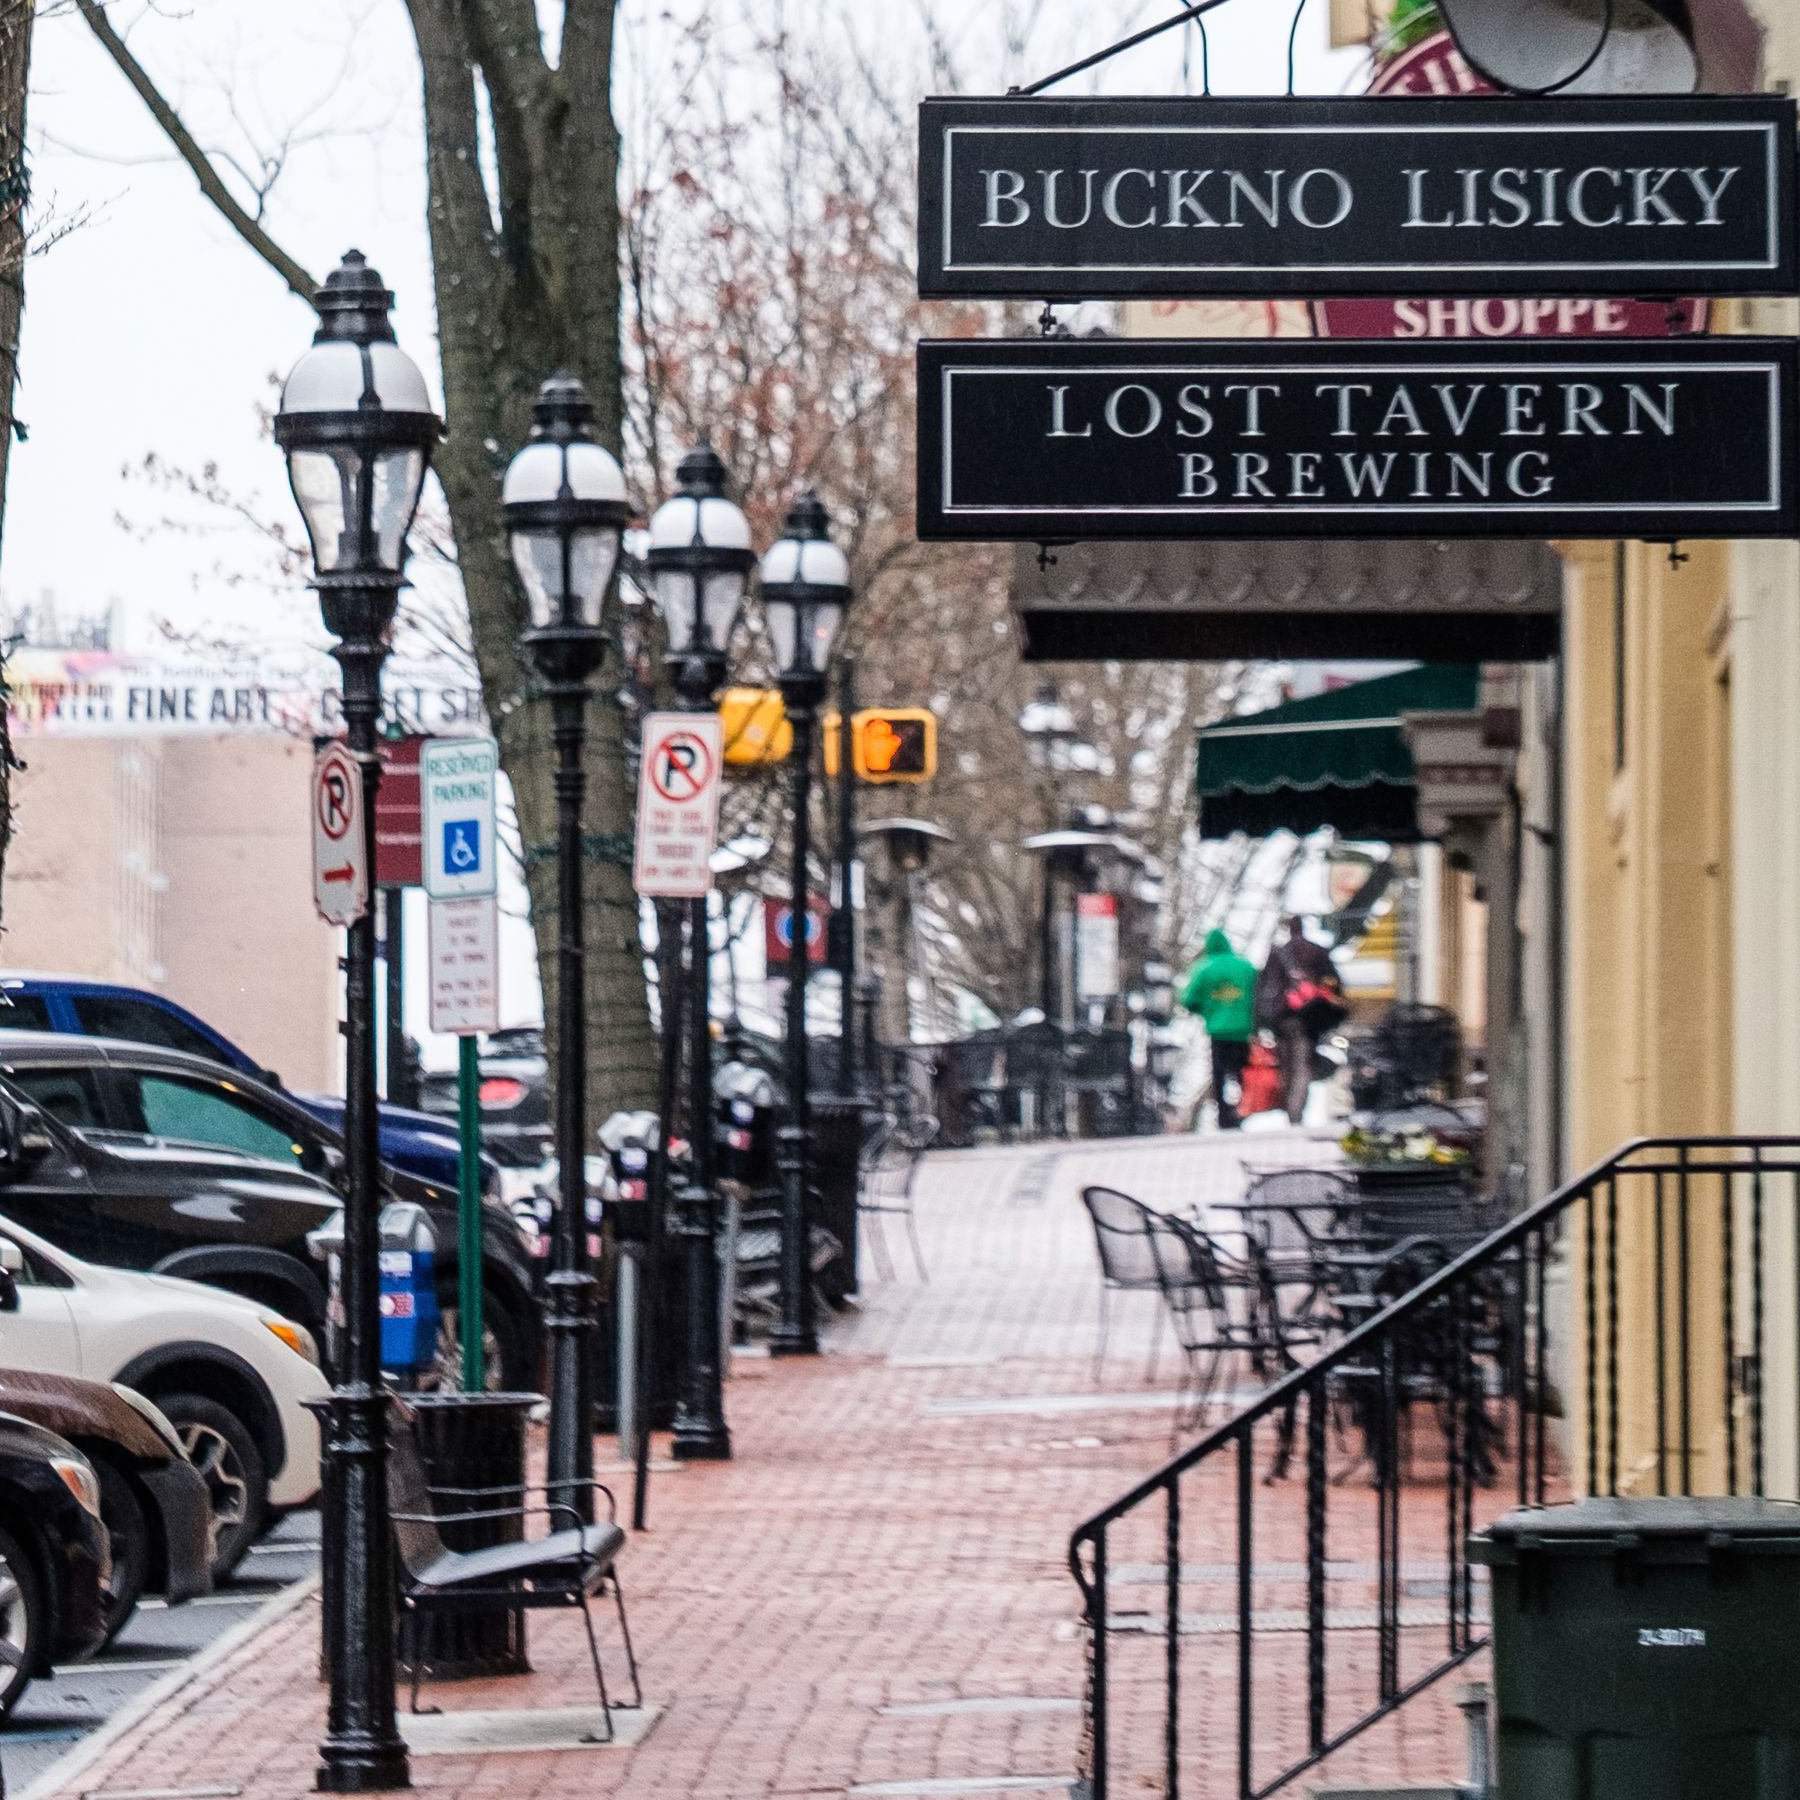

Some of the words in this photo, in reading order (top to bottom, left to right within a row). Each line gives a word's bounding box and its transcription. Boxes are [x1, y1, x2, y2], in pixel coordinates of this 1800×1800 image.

[978, 166, 1354, 230] BUCKNO
[1400, 165, 1741, 229] LISICKY
[1393, 299, 1628, 337] SHOPPE
[1045, 383, 1282, 439] LOST
[1315, 383, 1681, 438] TAVERN
[1177, 449, 1556, 499] BREWING
[128, 687, 195, 721] FINE
[209, 687, 269, 722] ART
